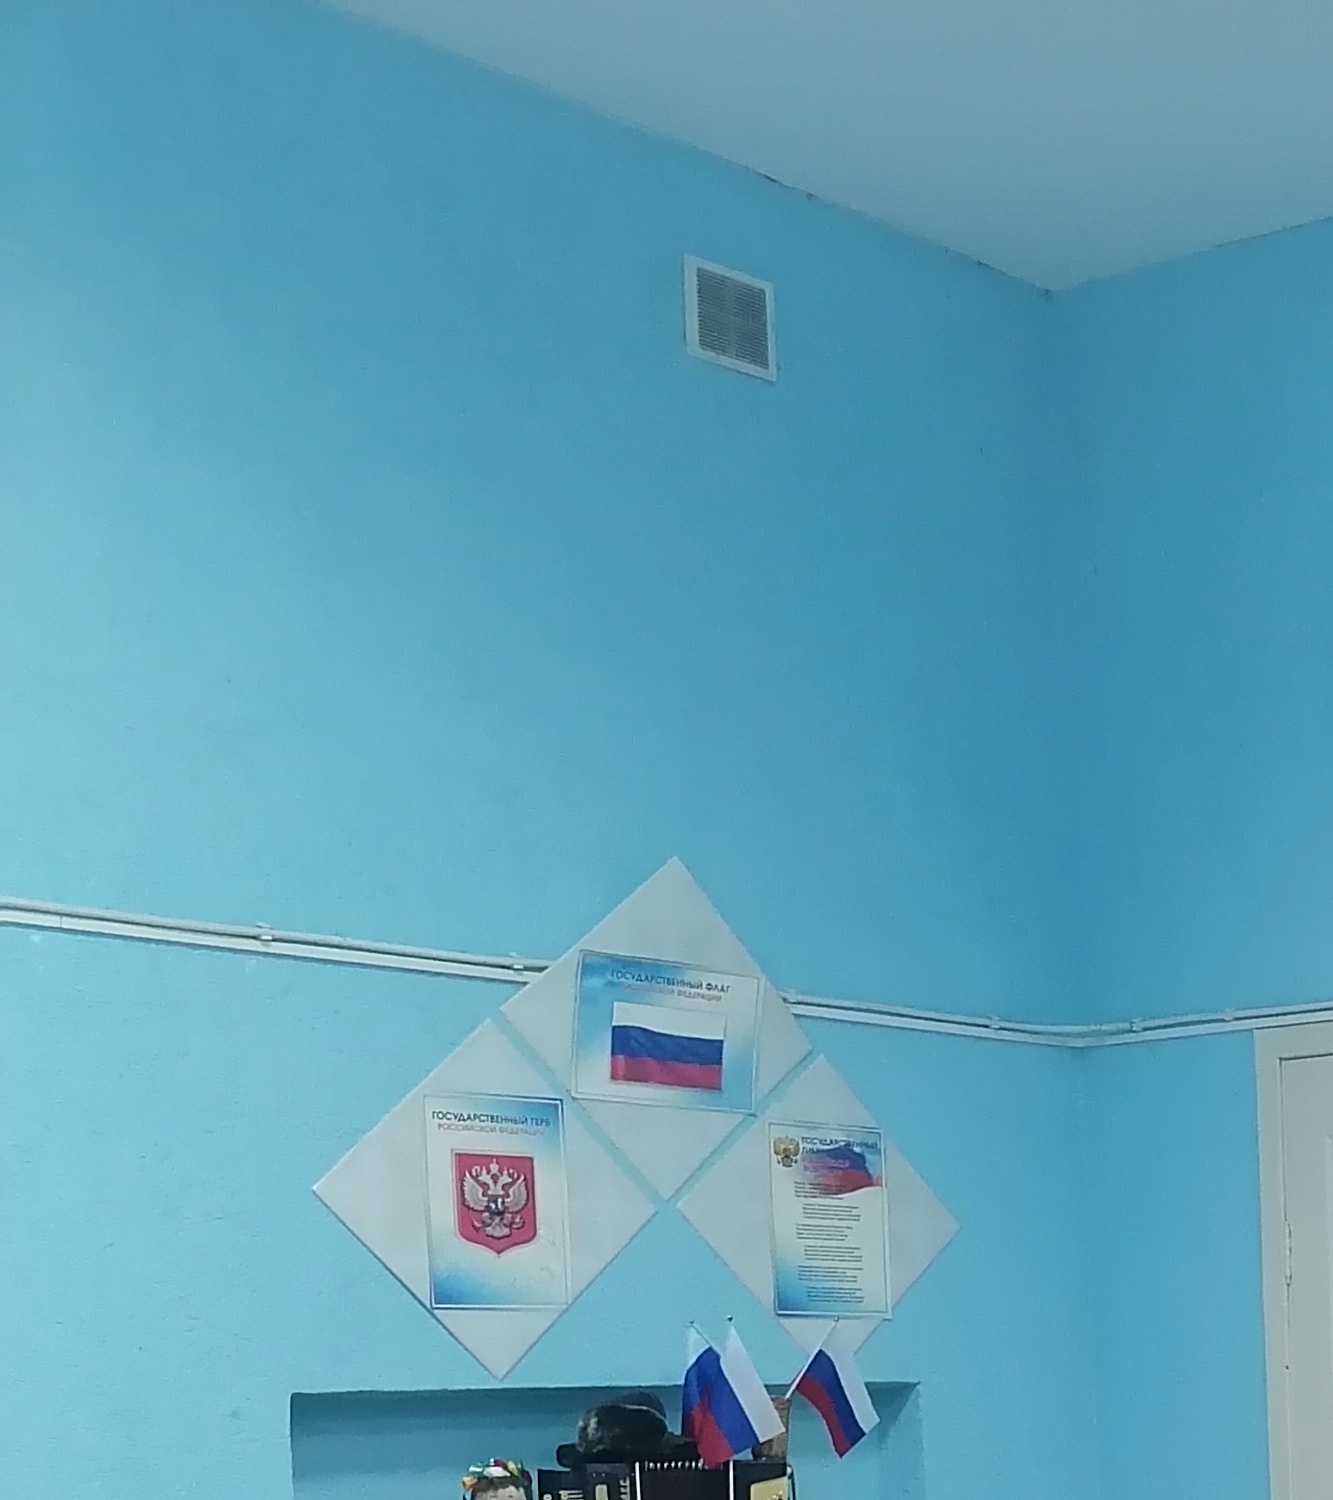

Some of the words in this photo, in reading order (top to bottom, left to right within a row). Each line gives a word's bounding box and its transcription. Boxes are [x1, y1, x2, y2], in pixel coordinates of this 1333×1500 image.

[610, 969, 704, 990] ГОСУДАРСТВЕННЫЙ
[705, 982, 731, 994] ФЛАГ
[431, 1110, 529, 1126] ГОСУДАРСТВЕННЫЙ
[530, 1117, 551, 1127] ГЕРБ
